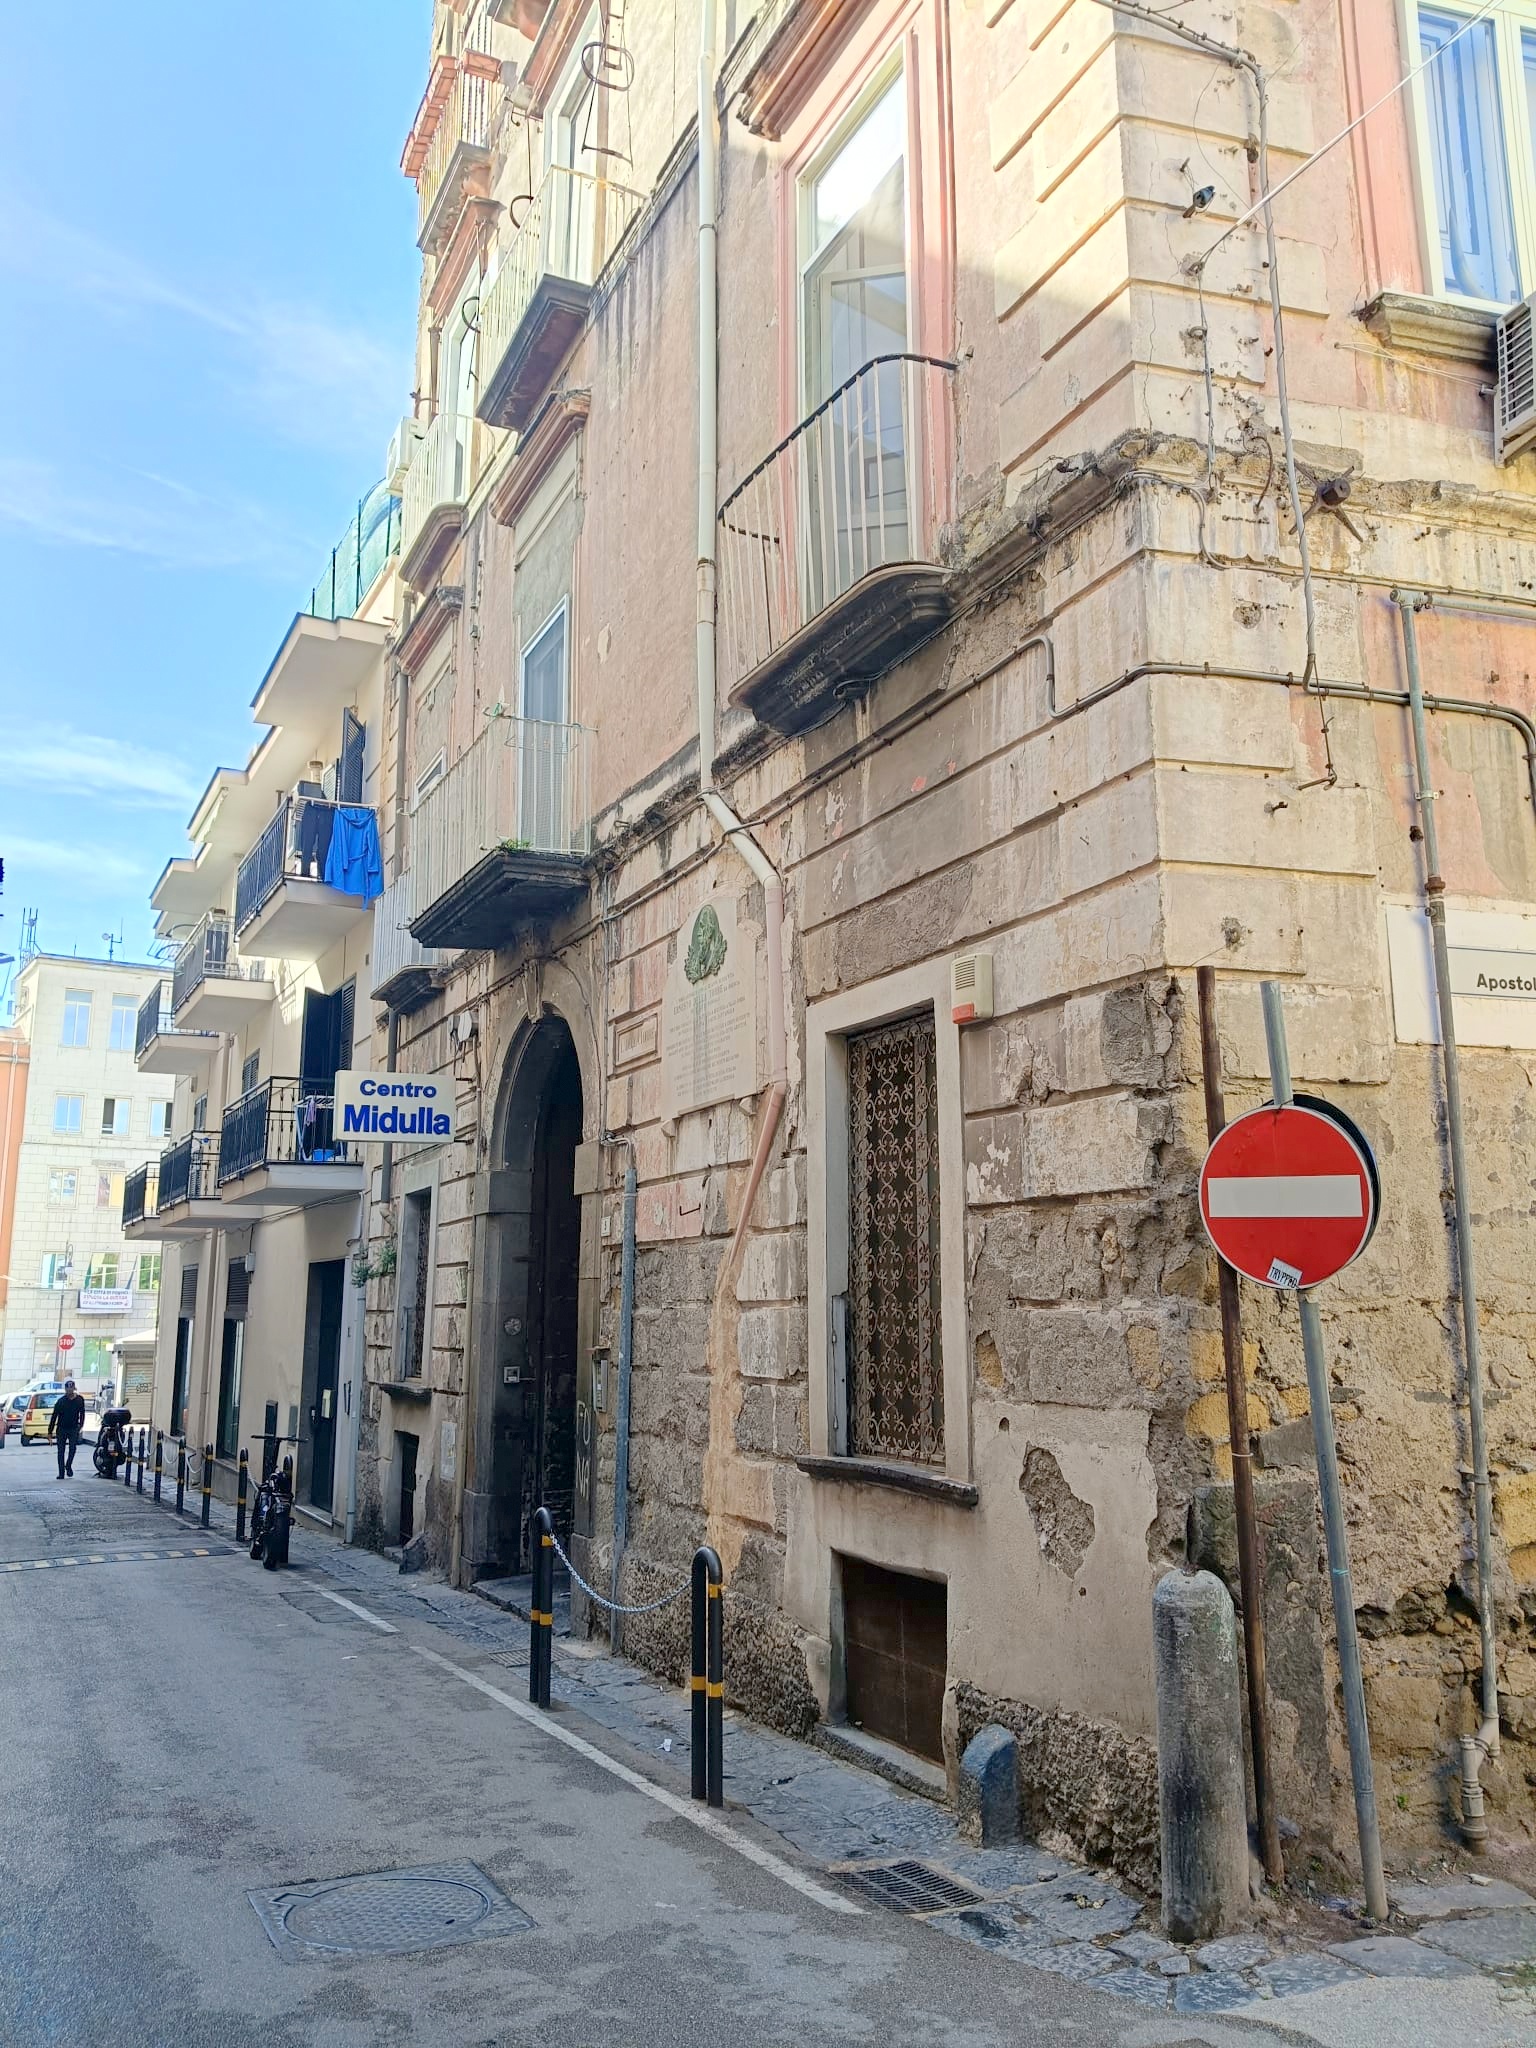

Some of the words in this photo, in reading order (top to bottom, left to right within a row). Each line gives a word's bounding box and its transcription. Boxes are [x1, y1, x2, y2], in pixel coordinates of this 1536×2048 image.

[360, 1079, 437, 1098] Centro
[343, 1104, 451, 1135] Midulla
[59, 1338, 75, 1346] STOP
